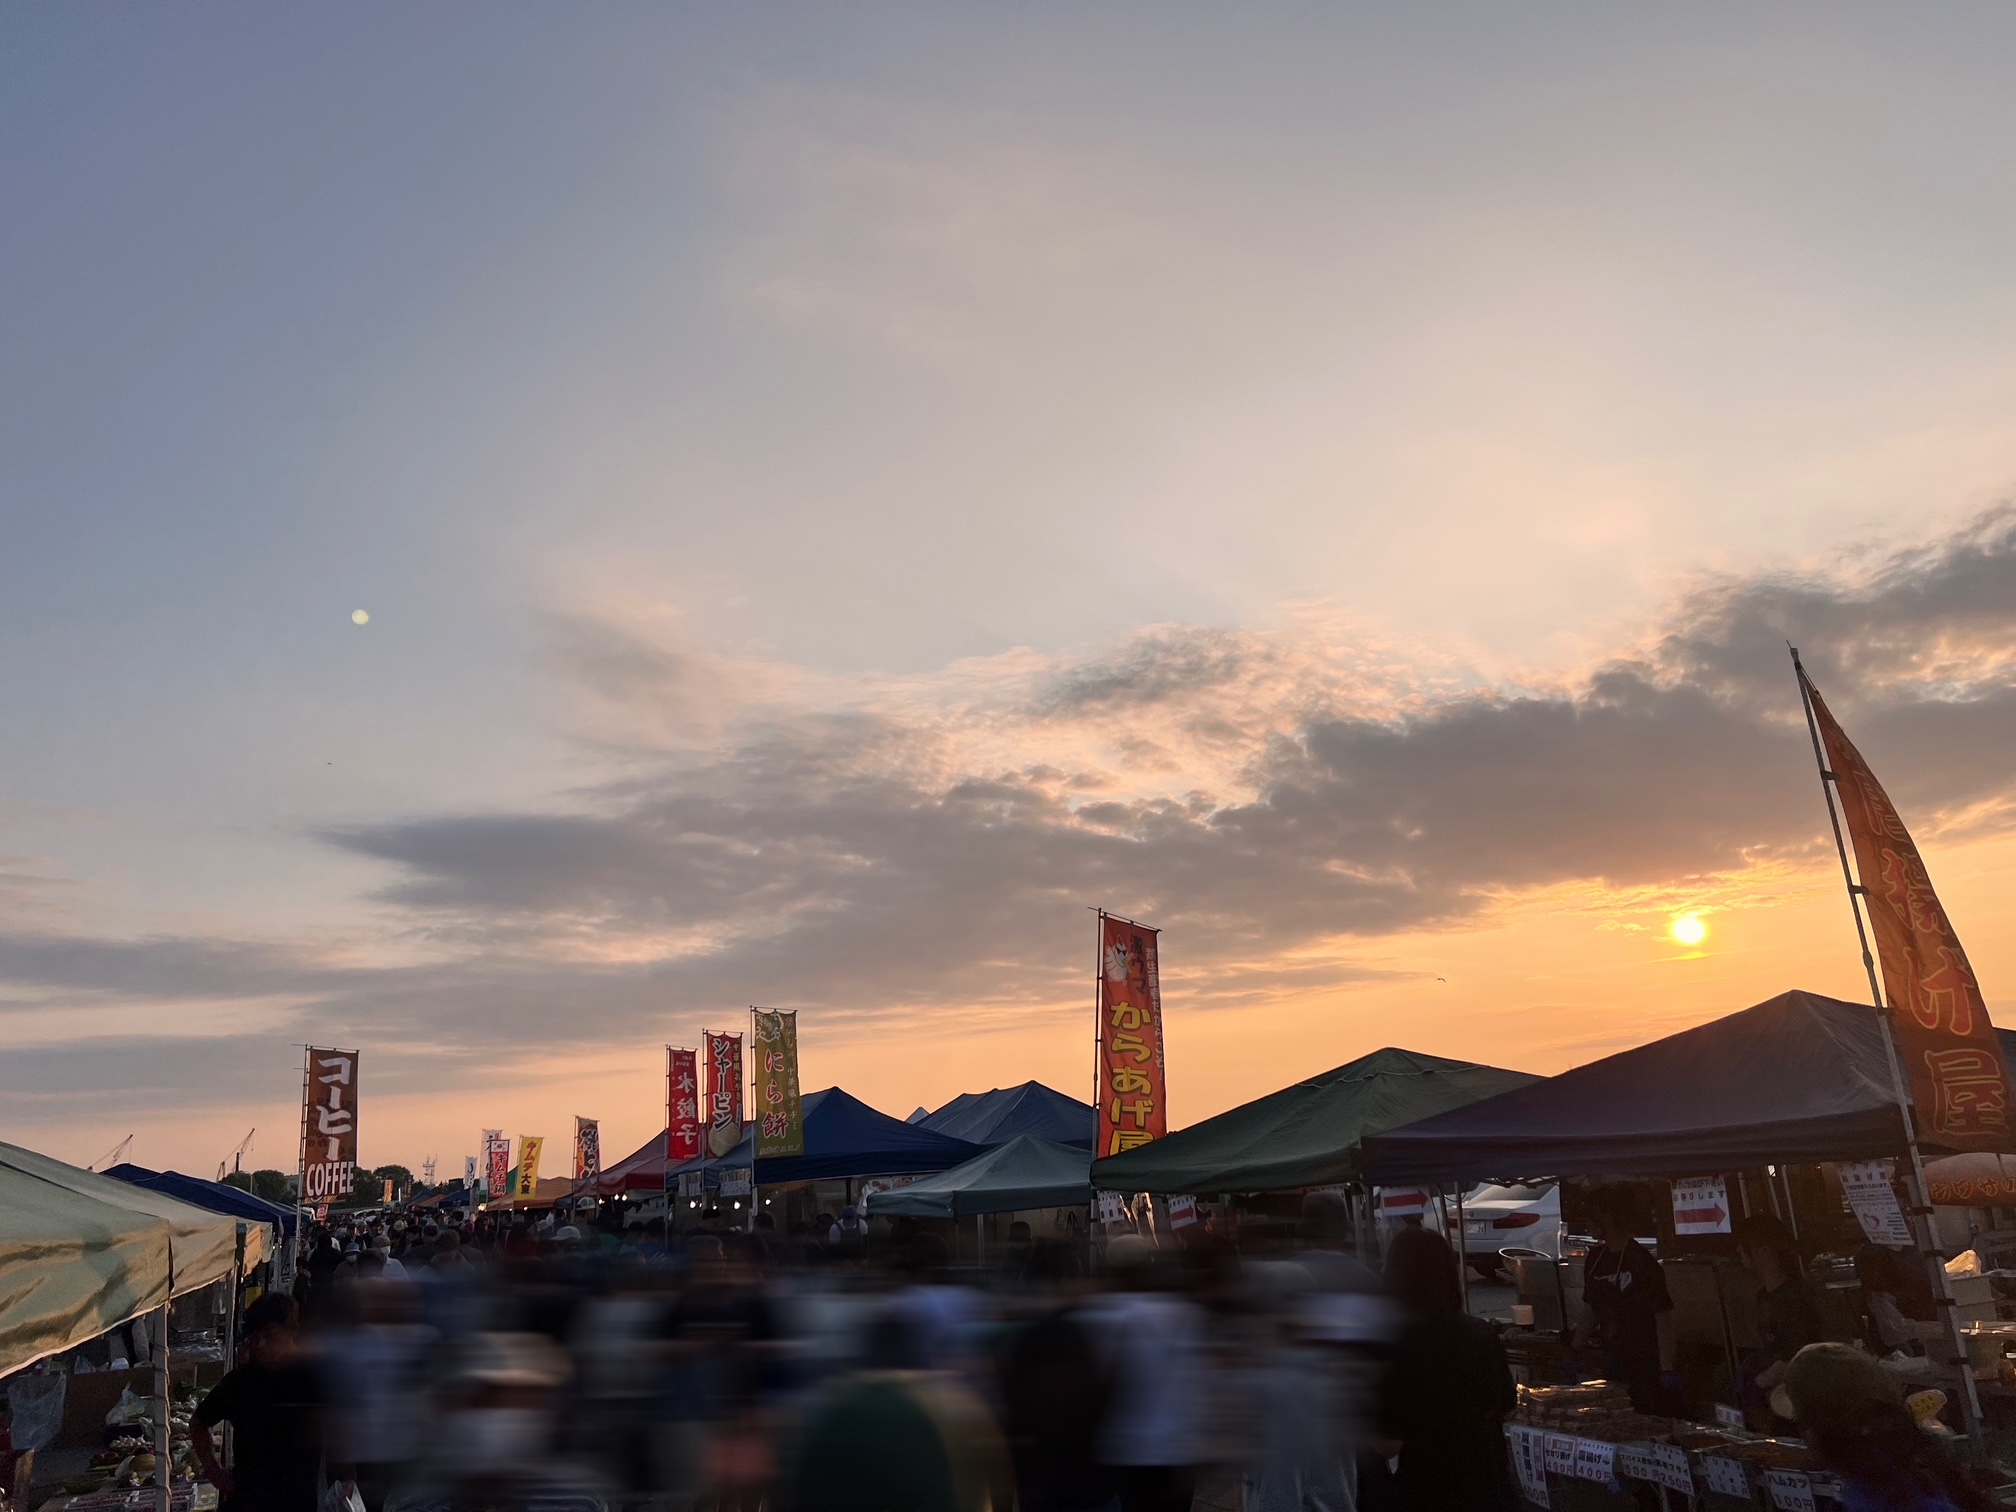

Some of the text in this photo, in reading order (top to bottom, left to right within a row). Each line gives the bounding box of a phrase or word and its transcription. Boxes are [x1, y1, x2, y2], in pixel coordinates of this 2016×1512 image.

[317, 1056, 352, 1161] コーヒー
[712, 1037, 732, 1132] シャーピン
[762, 1048, 789, 1139] にら餅
[306, 1161, 355, 1197] COFFEE
[494, 1153, 507, 1195] キムチ鍋
